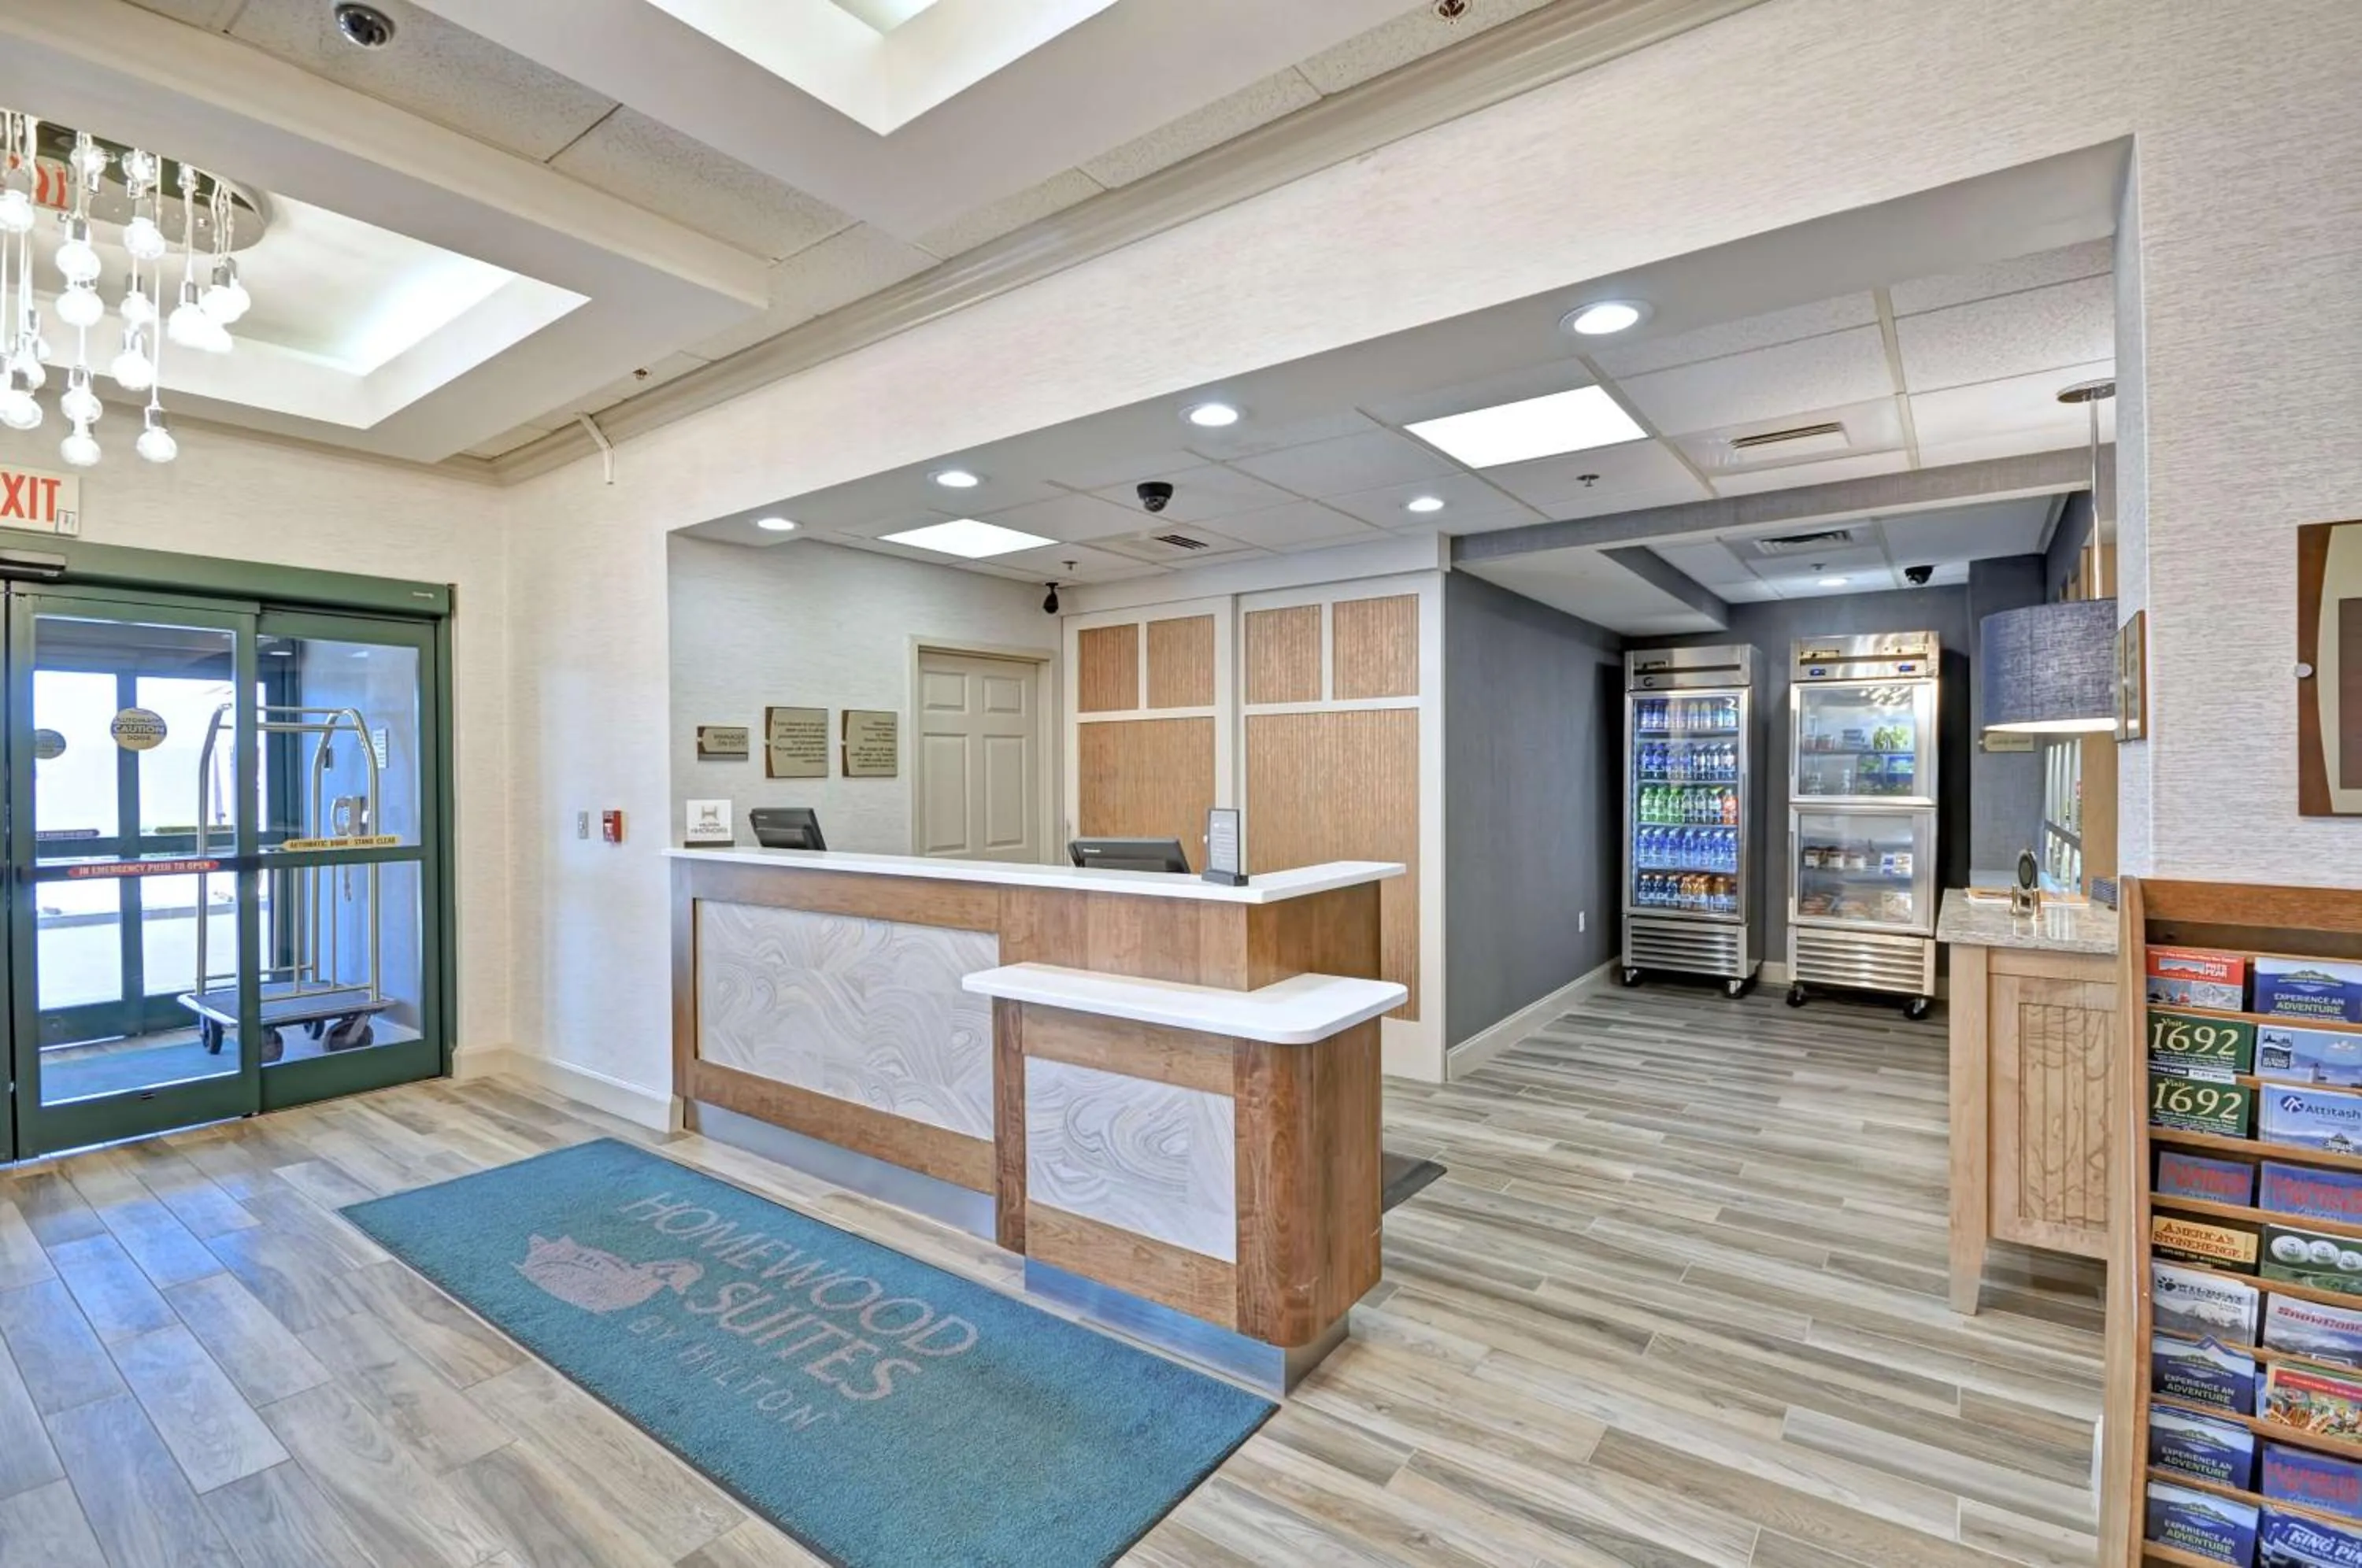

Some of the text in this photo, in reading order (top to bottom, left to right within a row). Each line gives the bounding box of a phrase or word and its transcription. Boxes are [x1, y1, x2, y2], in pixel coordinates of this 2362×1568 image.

[113, 724, 165, 733] CAUTION
[376, 836, 396, 845] CLEAR
[91, 864, 147, 875] EMERGENCY
[187, 860, 209, 870] OPEN
[2273, 993, 2345, 1005] EXPERIENCE AN
[2275, 1001, 2342, 1015] ADVENTURE
[2151, 1023, 2239, 1056] 1692
[2153, 1082, 2243, 1120] 1692
[2305, 1104, 2361, 1120] Attitash
[2153, 1230, 2241, 1258] STONEHENGE
[618, 1192, 979, 1356] HOMEWOOD
[684, 1281, 922, 1402] SUITES
[627, 1314, 827, 1433] BY HILTON
[2164, 1373, 2235, 1396] EXPERIENCE AN
[2166, 1383, 2231, 1404] ADVENTURE
[2160, 1445, 2233, 1471] EXPERIENCE AN
[2164, 1455, 2229, 1479] ADVENTURE
[2164, 1518, 2235, 1547] EXPERIENCE AN
[2166, 1528, 2231, 1555] ADVENTURE
[2289, 1529, 2334, 1551] KING
